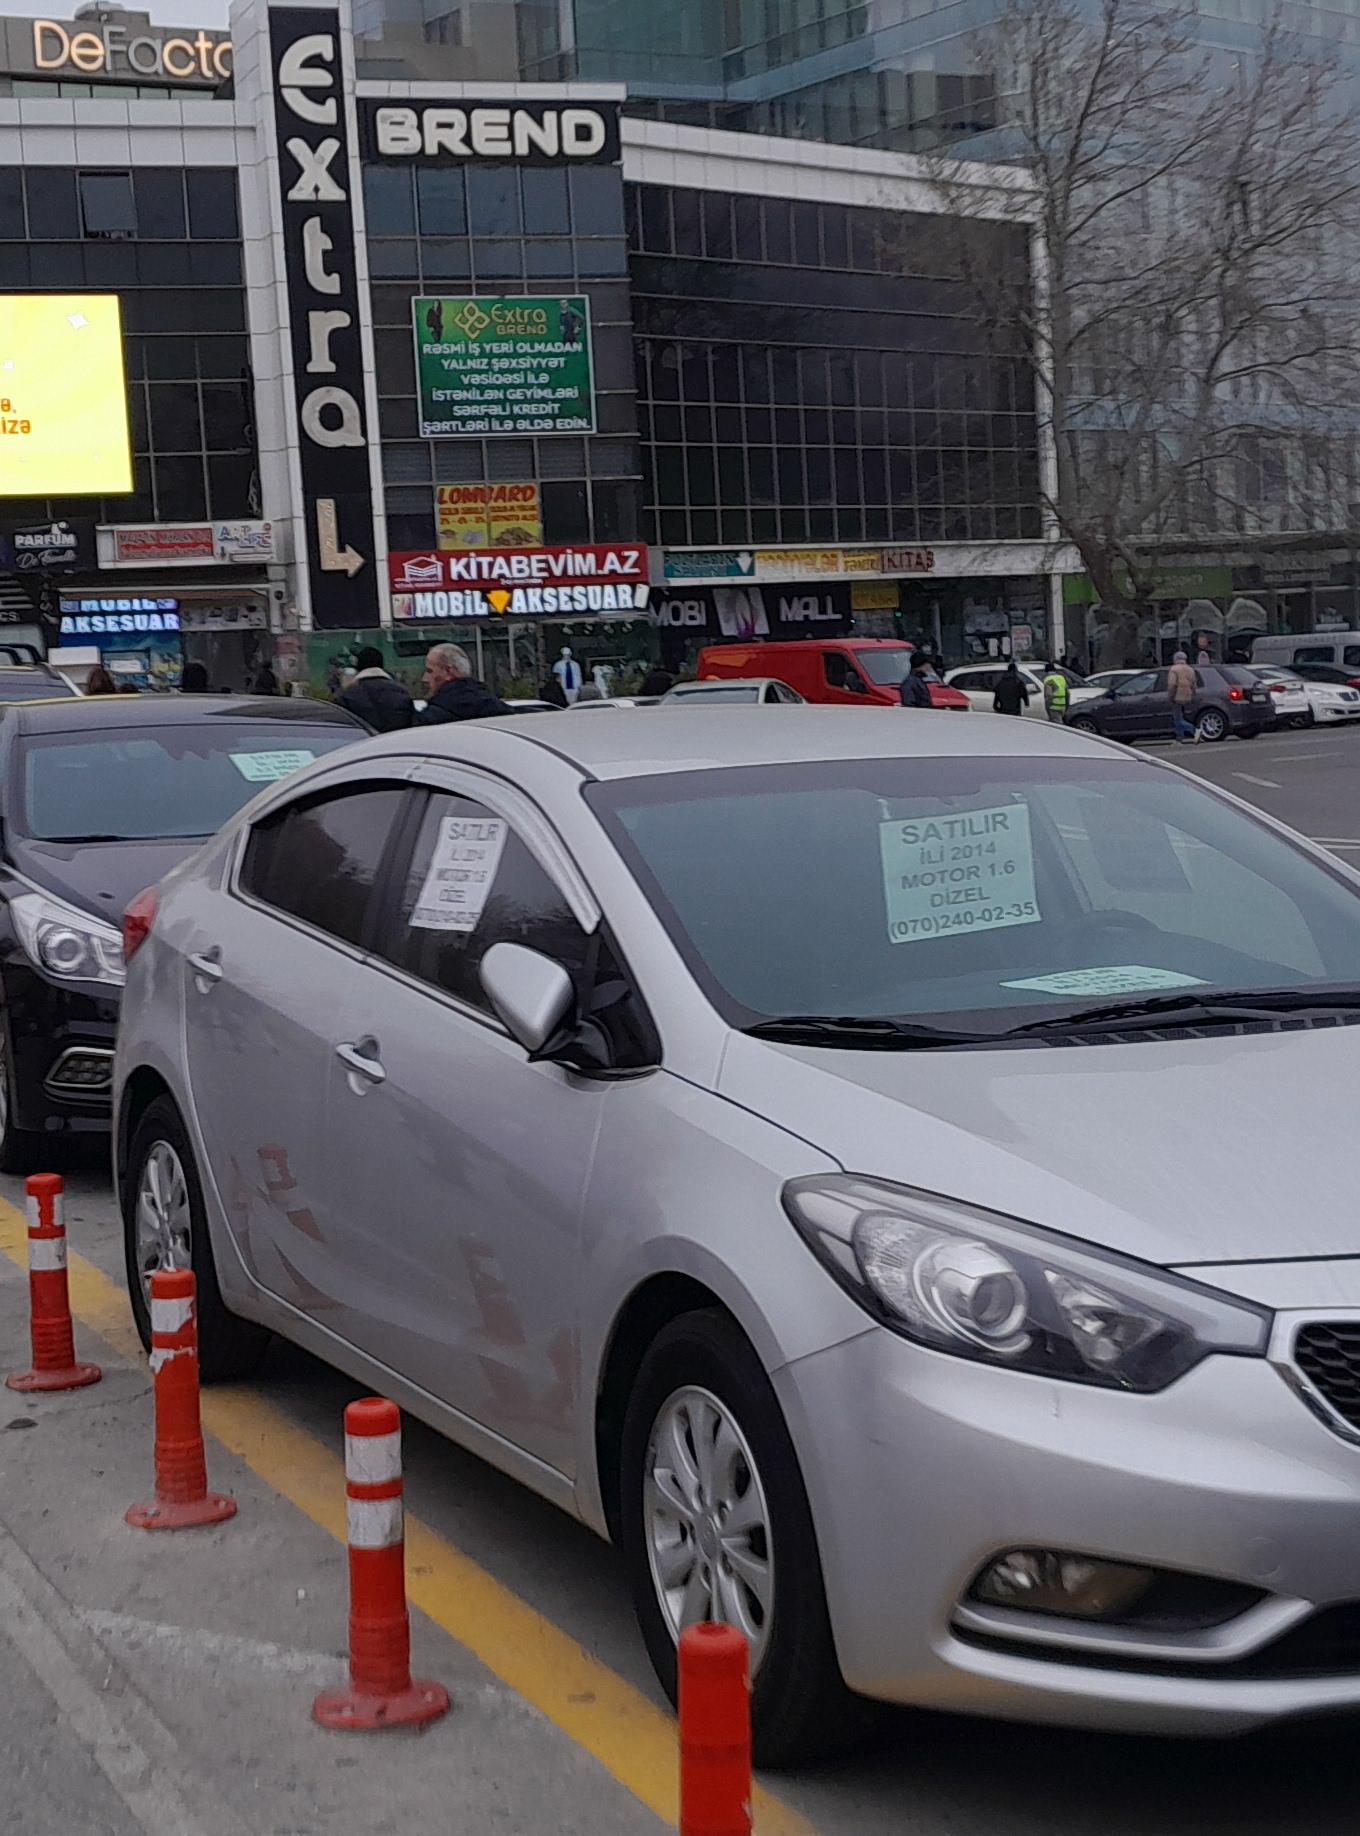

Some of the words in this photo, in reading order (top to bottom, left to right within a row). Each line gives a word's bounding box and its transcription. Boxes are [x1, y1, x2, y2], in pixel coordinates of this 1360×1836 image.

[375, 106, 606, 158] BREND
[279, 34, 366, 448] Extra
[491, 303, 547, 323] Extra
[495, 325, 548, 335] BREND
[422, 342, 466, 355] RƏSMİ
[516, 341, 583, 353] OLMADAN
[441, 358, 489, 370] YALNIZ
[491, 356, 566, 372] ŞƏXSİYYƏT
[513, 403, 561, 415] KREDİT
[423, 418, 489, 435] ŞƏRTLƏRİ
[491, 418, 514, 431] İLƏ
[516, 419, 553, 431] ƏLDƏ
[15, 534, 76, 548] PARFUM
[450, 549, 640, 581] KİTABEVİM.AZ
[415, 590, 488, 617] MOBİL
[512, 585, 634, 614] AKSESUAR
[648, 600, 706, 627] MOBI
[780, 596, 843, 621] MALL
[60, 613, 180, 633] AKSESUAR
[901, 812, 1010, 845] SATILIR
[951, 842, 996, 861] 2014
[901, 865, 981, 890] MOTOR
[988, 860, 1016, 878] 1.6
[930, 887, 991, 908] DİZEL
[891, 901, 1035, 940] (070)240-02-35
